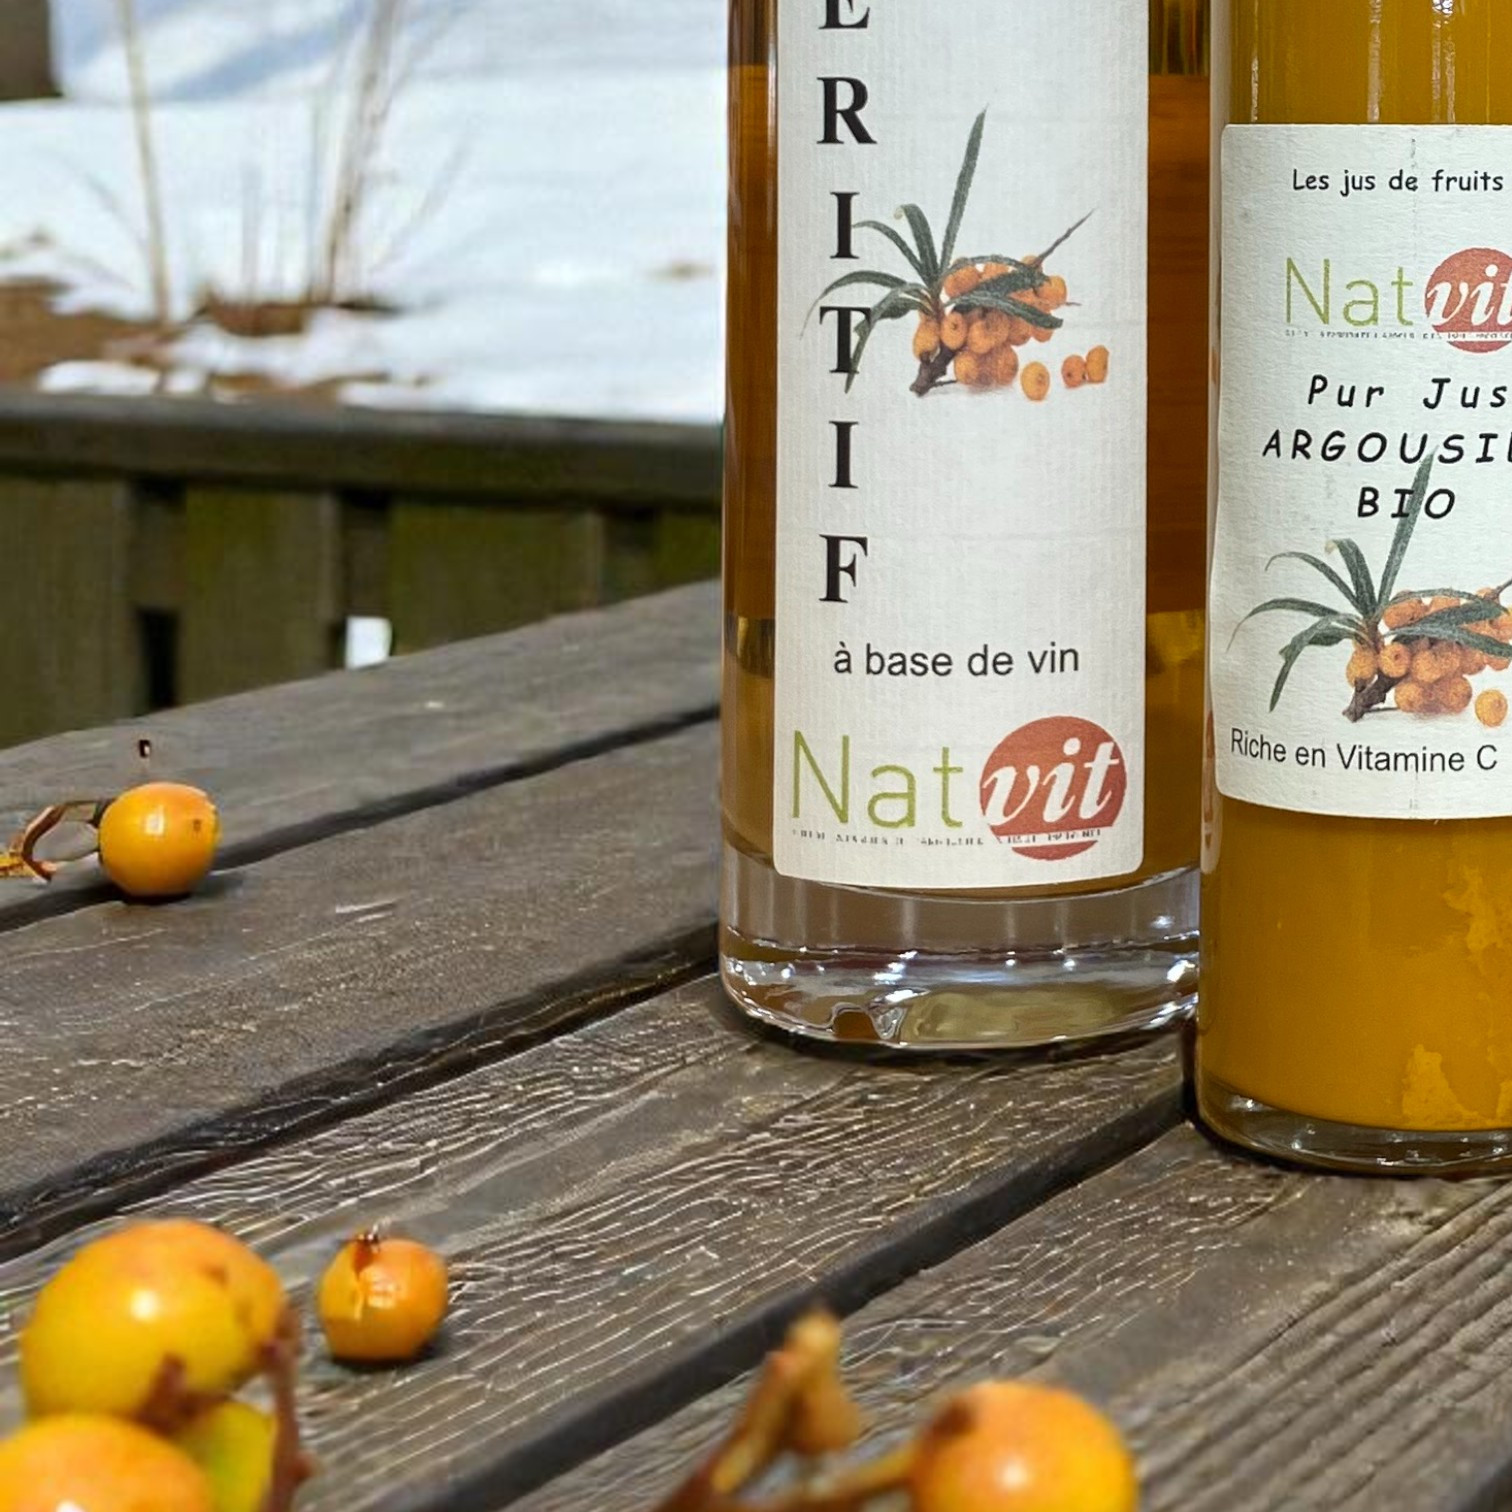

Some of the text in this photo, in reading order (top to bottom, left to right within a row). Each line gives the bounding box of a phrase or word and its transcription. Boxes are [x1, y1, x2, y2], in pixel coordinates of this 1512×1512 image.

[1292, 168, 1330, 191] Les
[1340, 169, 1376, 198] jus
[1388, 168, 1419, 192] de
[1431, 169, 1504, 193] fruits
[1307, 374, 1508, 410] Pur Jus
[1357, 486, 1456, 520] BIO
[833, 641, 1079, 677] à base de vin
[1231, 727, 1498, 773] Riche en Vitamine C
